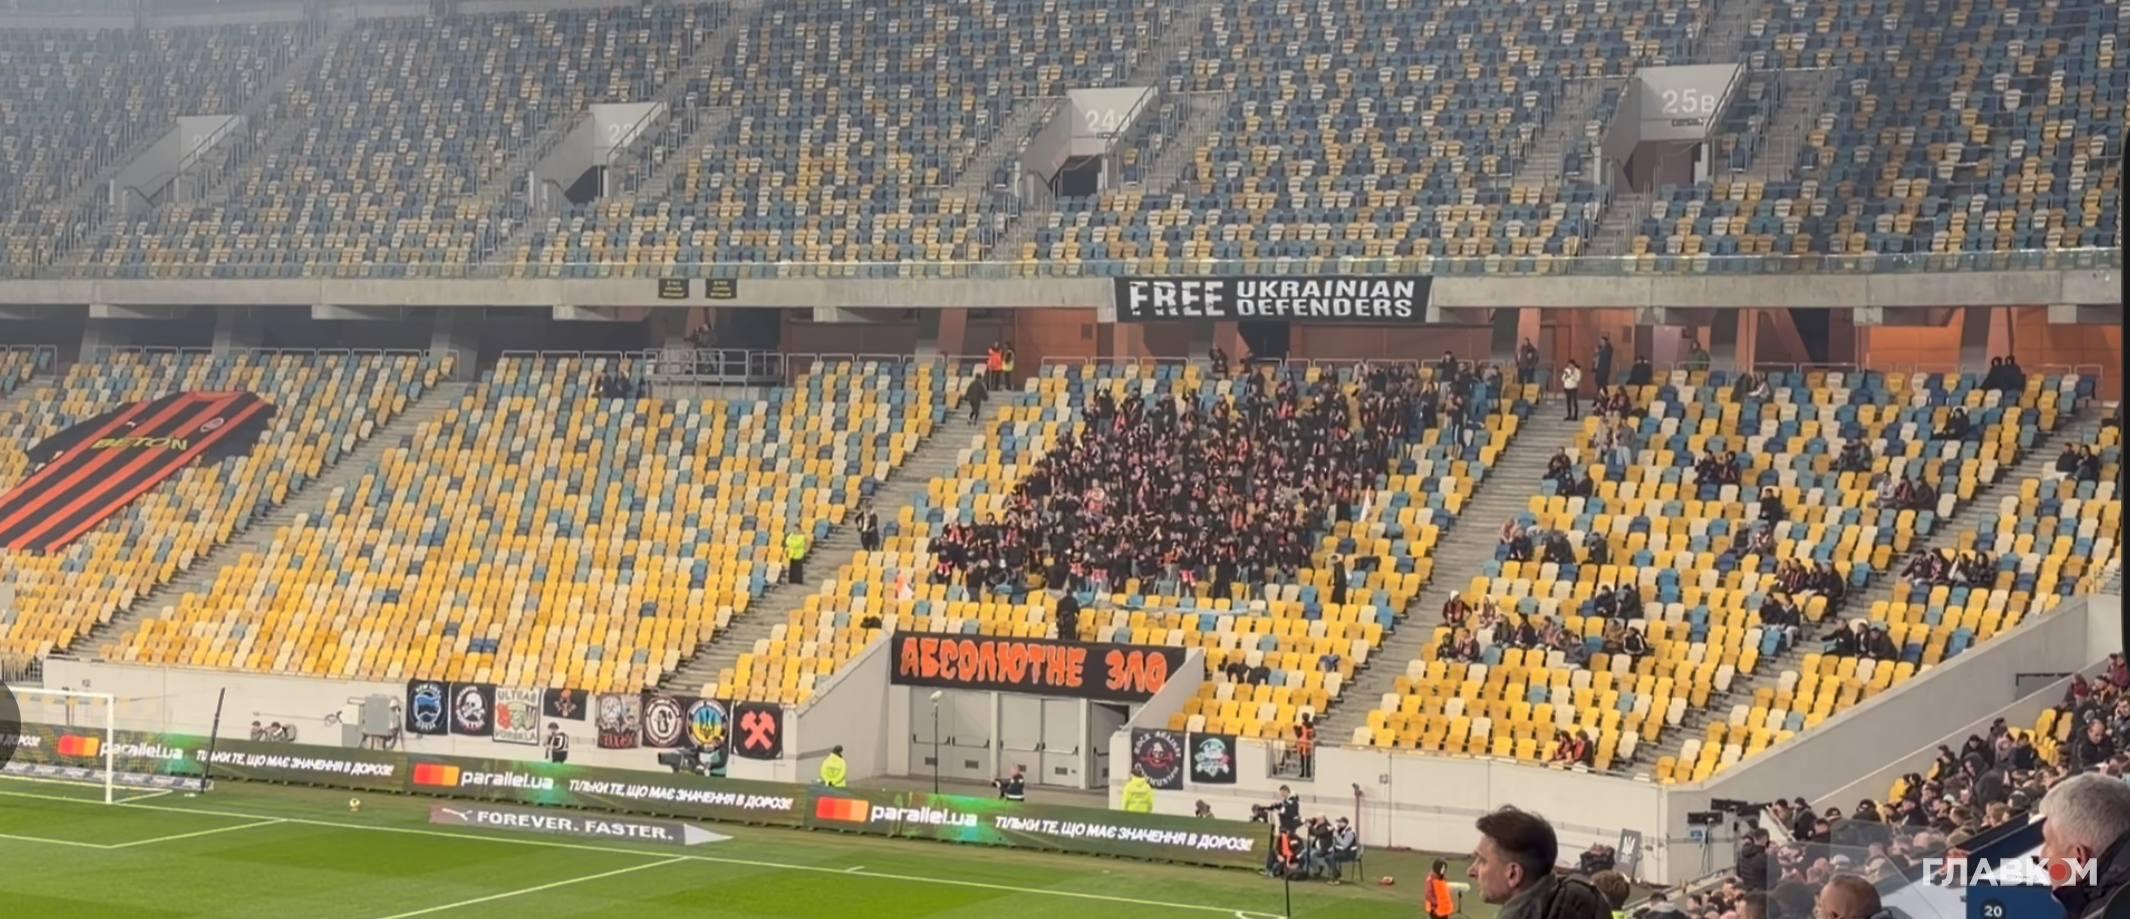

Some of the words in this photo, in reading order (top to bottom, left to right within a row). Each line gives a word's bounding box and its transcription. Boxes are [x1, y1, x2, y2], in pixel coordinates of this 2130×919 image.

[1129, 281, 1225, 316] FREE
[1236, 280, 1415, 299] UKRAINIAN
[1236, 299, 1412, 317] DEFENDERS
[900, 636, 1087, 688] АБСОЛЮТНЕ
[1105, 649, 1167, 693] ЗЛО
[497, 690, 537, 704] ULTRAS
[100, 742, 183, 760] parallel.ua
[461, 771, 553, 790] parallel.ua
[569, 779, 609, 793] ТІЛЬКИ
[626, 783, 648, 800] ЩО
[649, 786, 675, 800] МАЄ
[675, 788, 736, 806] ЗНАЧЕННЯ
[735, 794, 745, 806] В
[477, 810, 579, 831] FOREVER.
[585, 820, 674, 840] FASTER.
[871, 805, 977, 826] parallel.ua
[995, 816, 1039, 831] ТІЛЬКИ
[1061, 821, 1085, 840] ЩО
[1086, 823, 1116, 839] МАЄ
[1118, 828, 1186, 846] ЗНАЧЕННЯ
[1186, 834, 1197, 846] В
[1984, 905, 2003, 917] 20
